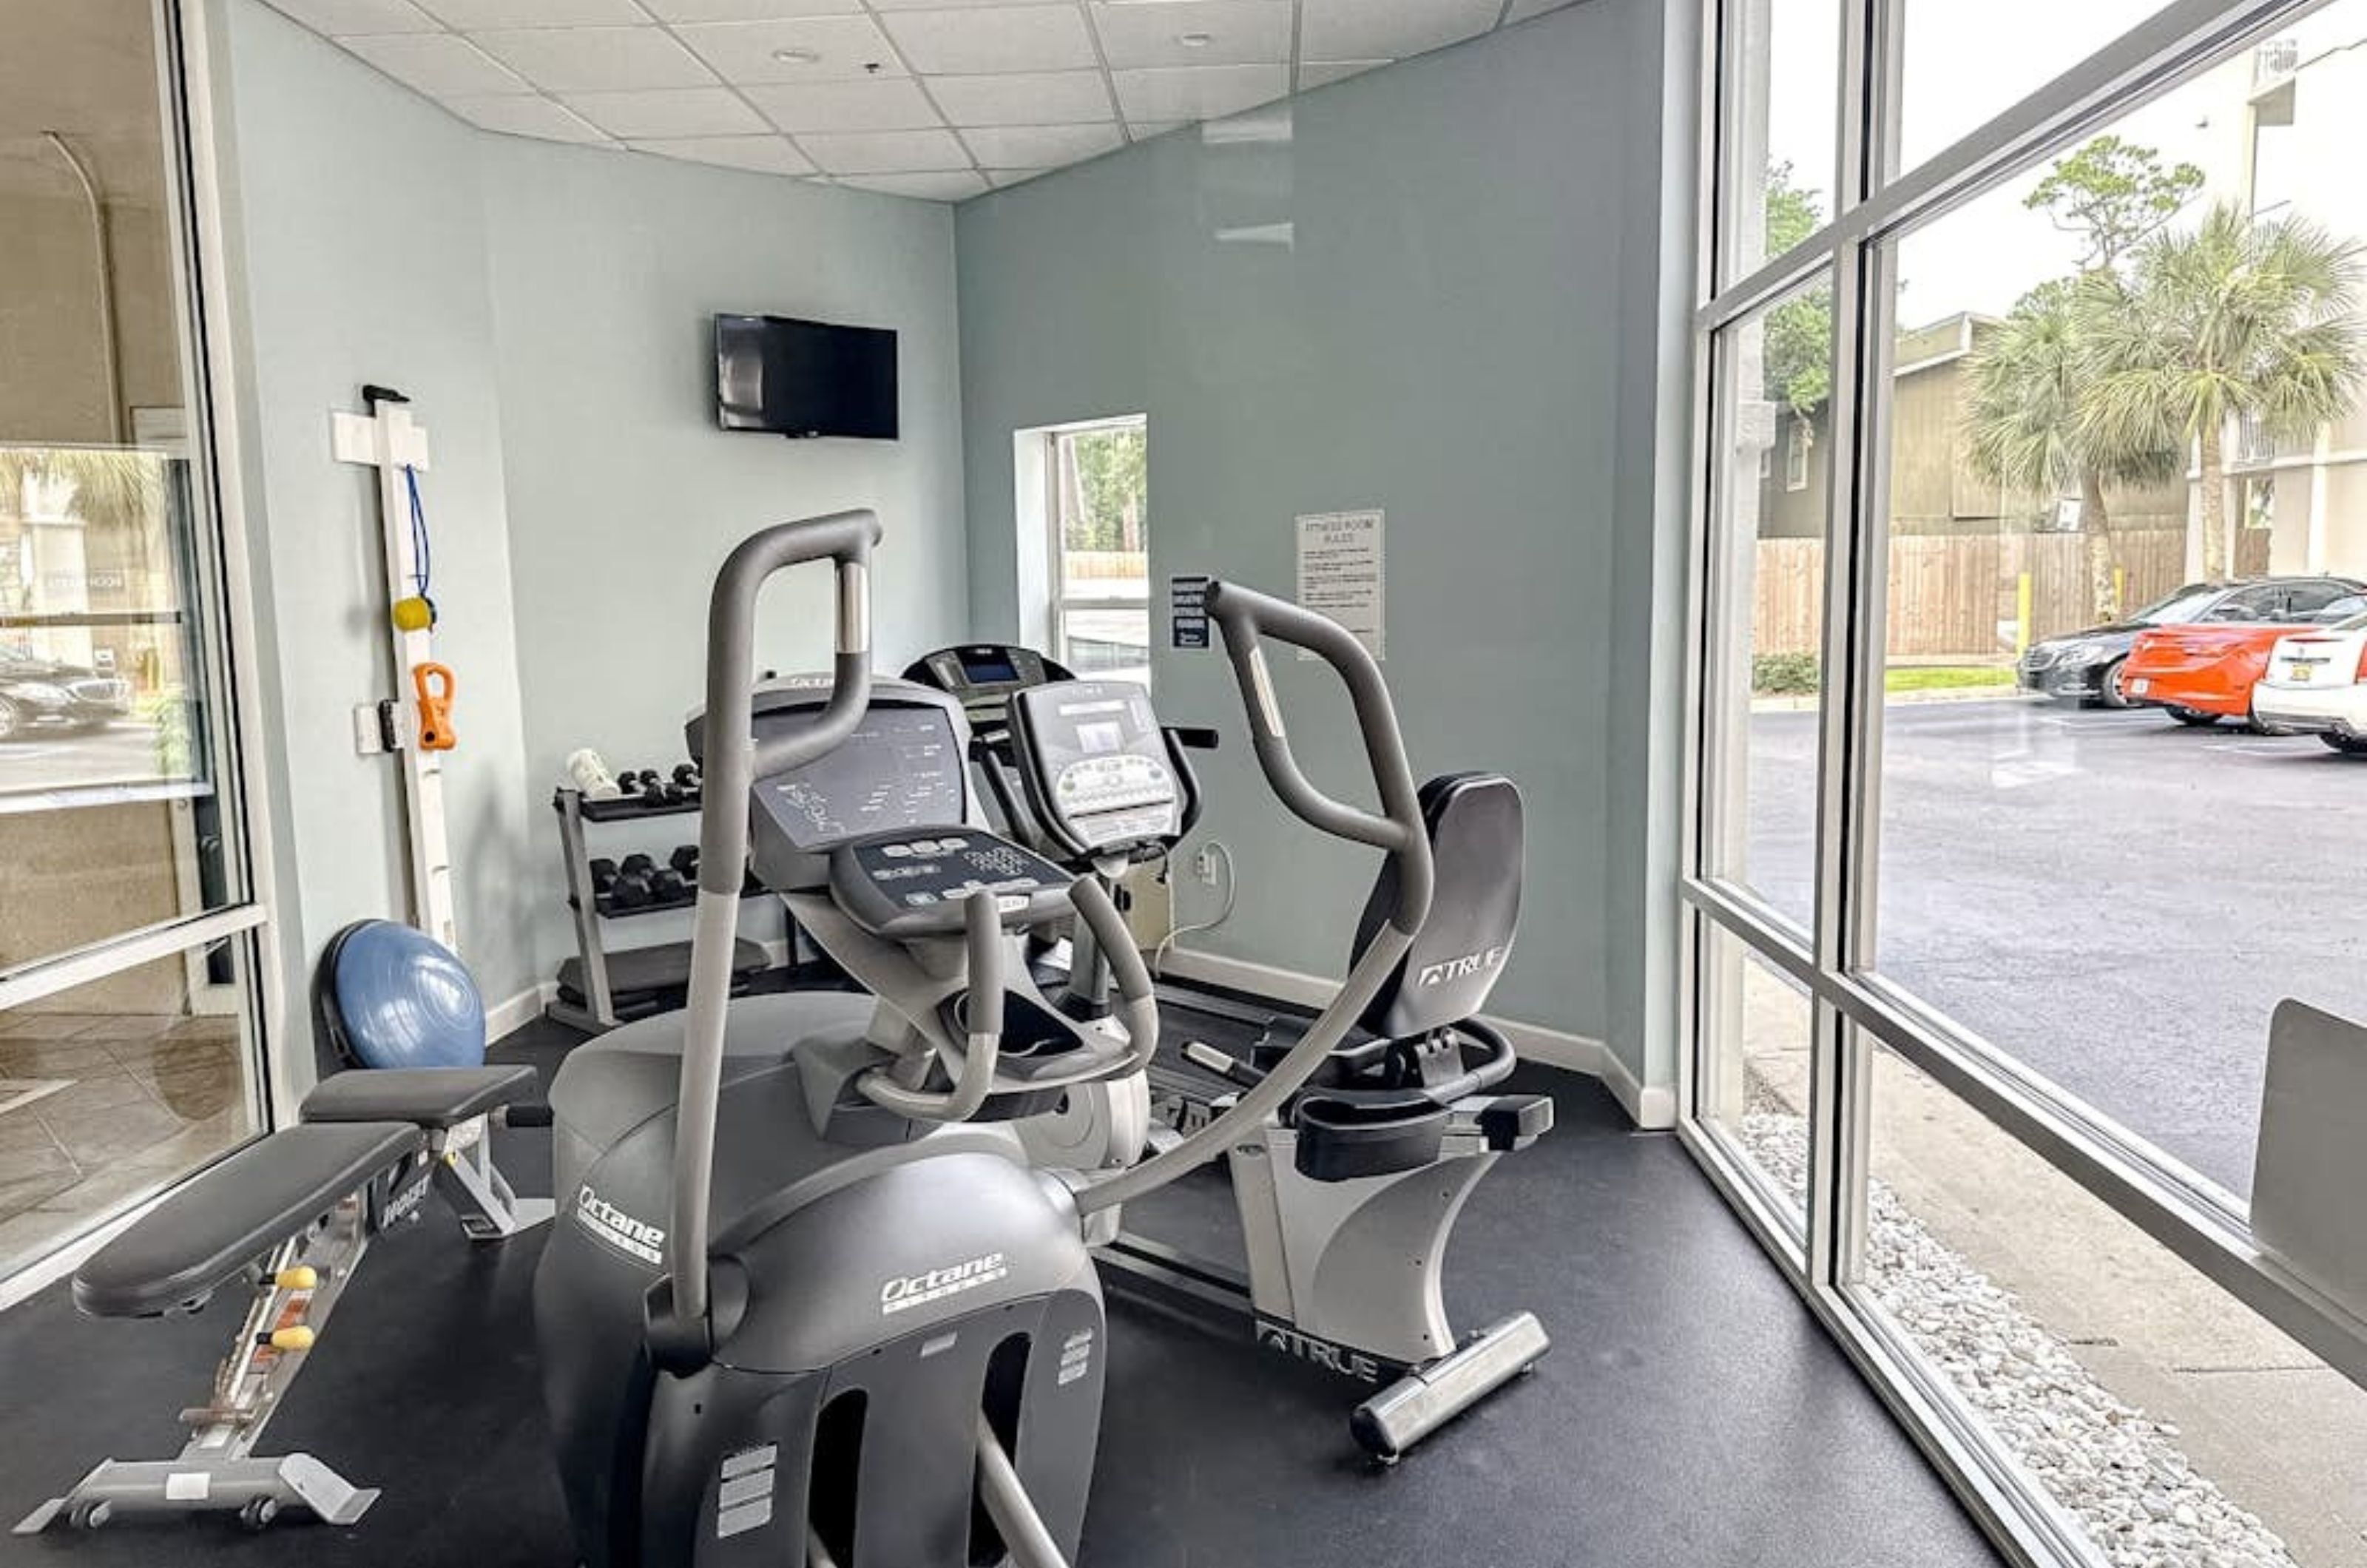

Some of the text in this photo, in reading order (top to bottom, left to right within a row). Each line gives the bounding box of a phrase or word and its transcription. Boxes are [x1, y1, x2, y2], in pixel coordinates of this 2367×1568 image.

[579, 1183, 665, 1248] Octane
[881, 1253, 1002, 1302] Octane
[1289, 1332, 1378, 1384] TRUE
